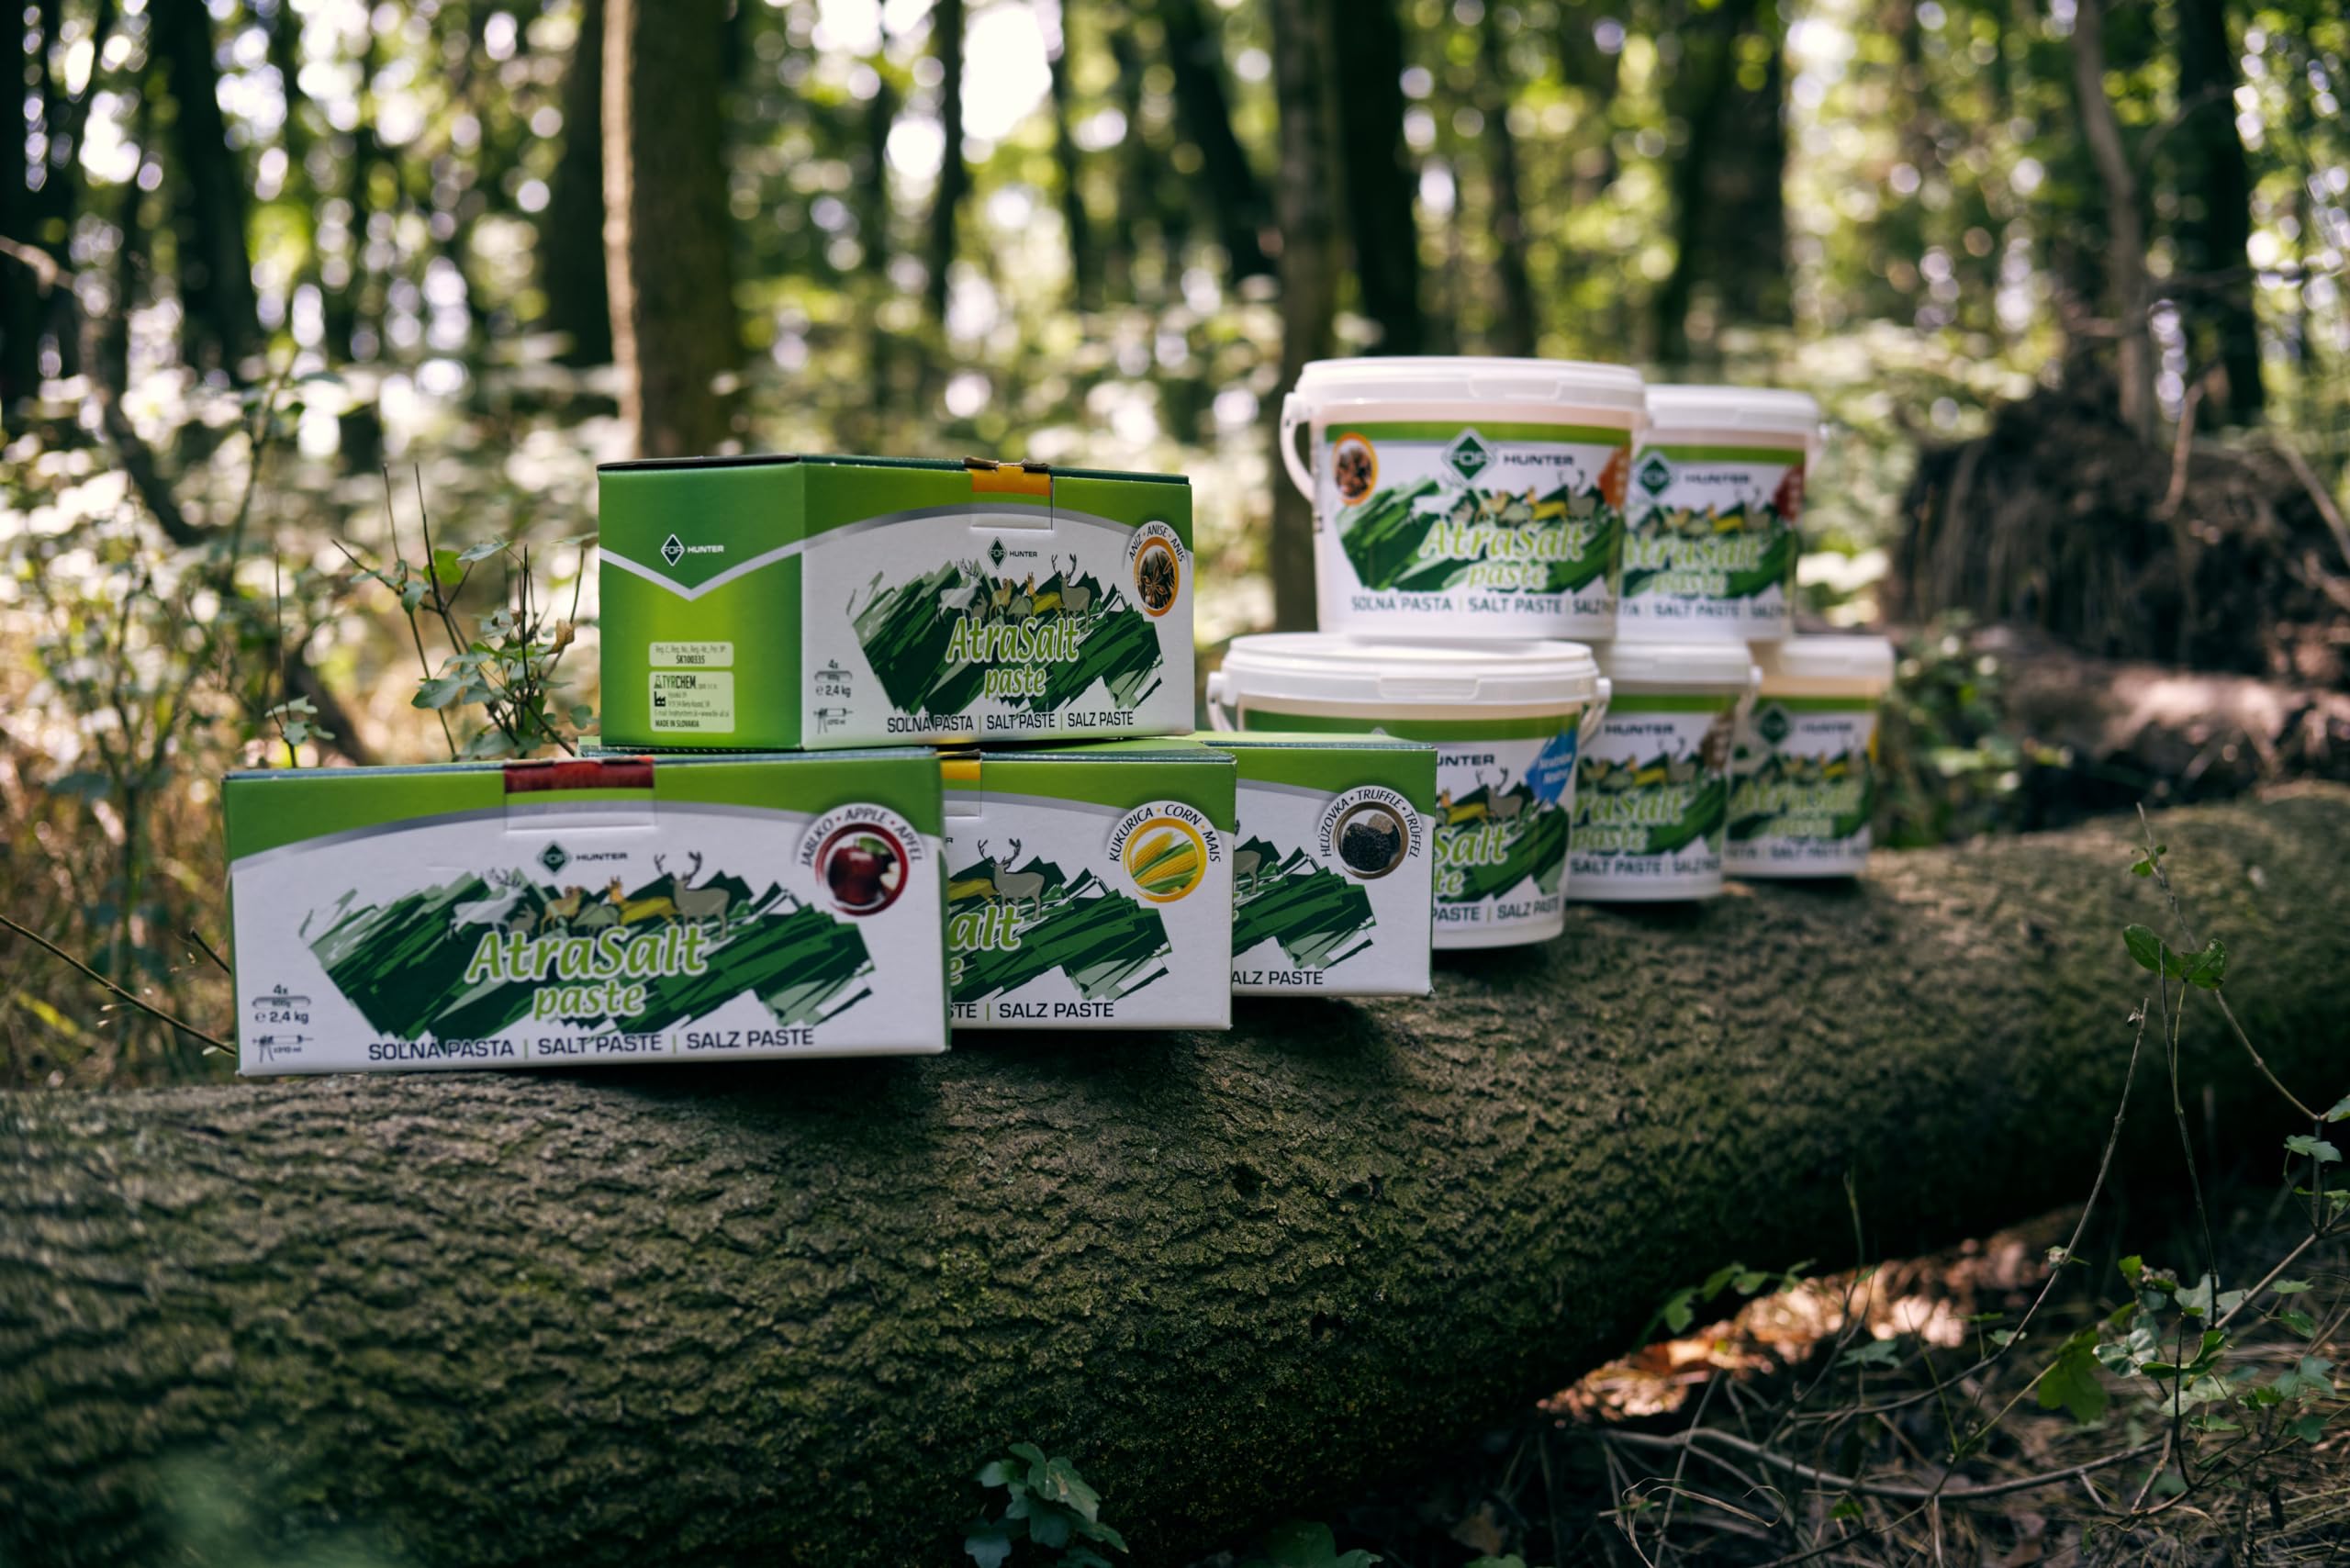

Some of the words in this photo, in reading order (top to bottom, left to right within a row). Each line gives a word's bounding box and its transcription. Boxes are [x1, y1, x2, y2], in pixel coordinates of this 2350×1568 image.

[1504, 454, 1573, 465] HUNTER
[687, 544, 724, 554] HUNTER
[1147, 524, 1169, 537] ANISE
[1170, 538, 1185, 562] ANIS
[1417, 519, 1584, 563] AtraSalt
[1467, 562, 1549, 589] paste
[1402, 597, 1452, 611] PASTA
[1469, 598, 1508, 613] SALT
[1515, 599, 1562, 614] PASTE
[1654, 603, 1692, 617] SALT
[1697, 603, 1740, 617] PASTE
[946, 616, 1080, 663] AtraSalt
[842, 685, 851, 698] kg
[984, 665, 1046, 700] paste
[934, 715, 974, 732] PASTA
[987, 715, 1015, 731] SALT
[1019, 713, 1055, 729] PASTE
[1068, 711, 1096, 727] SALZ
[1100, 711, 1134, 726] PASTE
[1605, 724, 1675, 734] HUNTER
[1437, 755, 1495, 766] UNTER
[1572, 787, 1684, 823] raSalt
[1109, 807, 1154, 862] KUKURICA
[1165, 804, 1203, 825] CORN
[1203, 830, 1221, 863] MAIS
[1356, 789, 1404, 809] TRUFFLE
[1404, 810, 1423, 858] TRÜFFEL
[800, 818, 834, 867] JABLKO
[845, 807, 887, 823] APPLE
[895, 825, 923, 862] APFEL
[1434, 825, 1508, 866] Salt
[576, 853, 628, 861] HUNTER
[1571, 858, 1608, 872] SALT
[1615, 858, 1661, 872] PASTE
[1498, 902, 1532, 919] SALZ
[1534, 897, 1559, 914] PASTE
[464, 925, 709, 984] AtraSalt
[1232, 970, 1263, 985] ALZ
[1269, 970, 1324, 985] PASTE
[533, 981, 645, 1020] paste
[999, 1003, 1047, 1019] SALZ
[1054, 1002, 1114, 1018] PASTE
[270, 1011, 290, 1024] 2,4
[295, 1011, 309, 1025] kg
[447, 1039, 514, 1058] PASTA
[538, 1037, 588, 1056] SALT
[597, 1035, 662, 1053] PASTE
[687, 1031, 740, 1050] SALZ
[748, 1028, 813, 1047] PASTE
